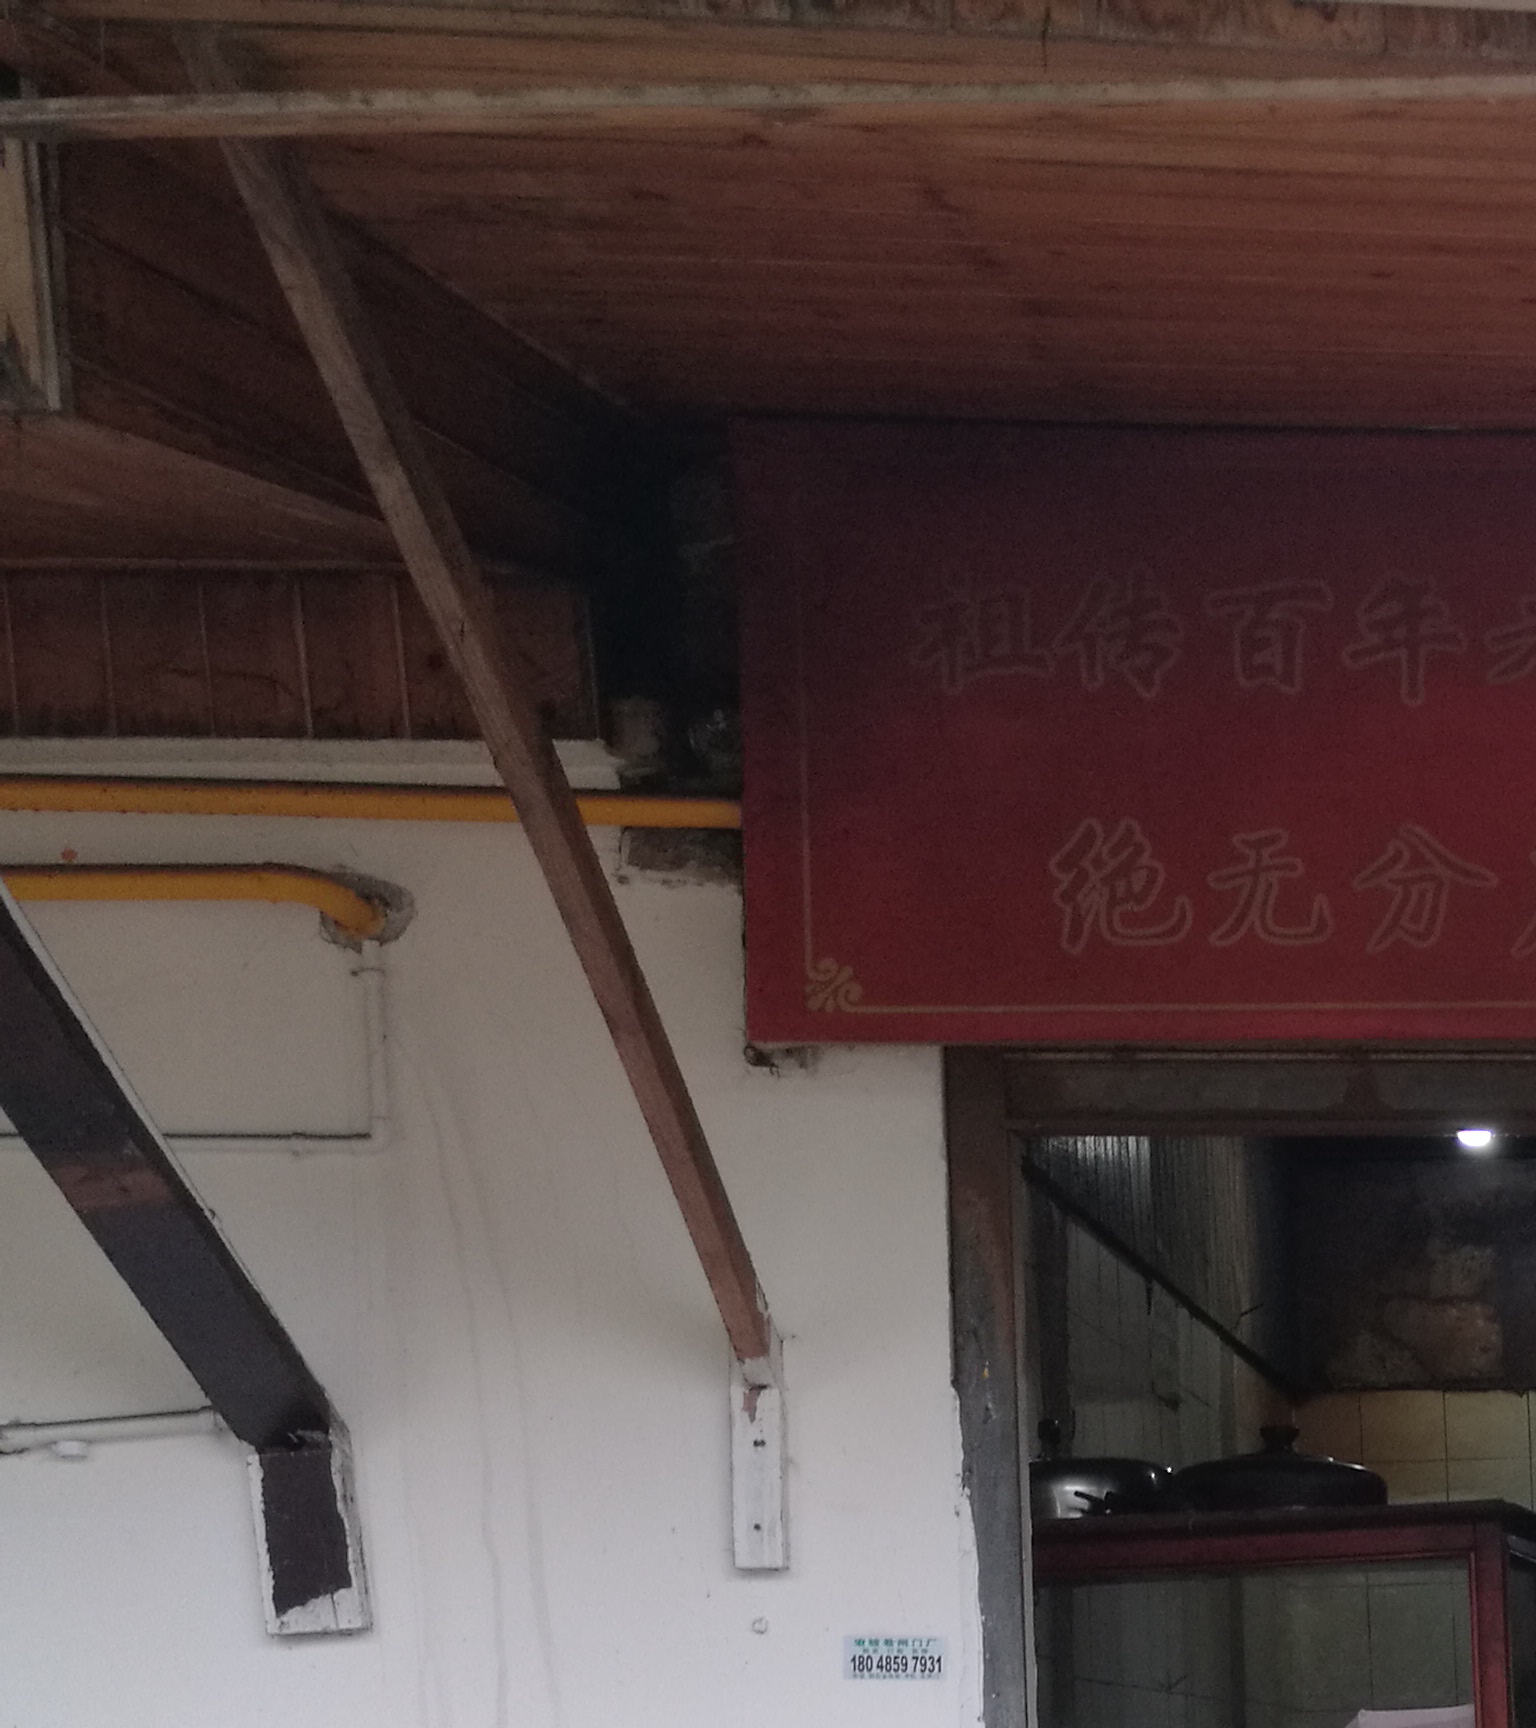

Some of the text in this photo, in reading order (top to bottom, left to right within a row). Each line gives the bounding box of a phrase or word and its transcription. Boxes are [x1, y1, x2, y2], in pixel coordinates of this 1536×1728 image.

[851, 1654, 942, 1673] 180 4859 7931
